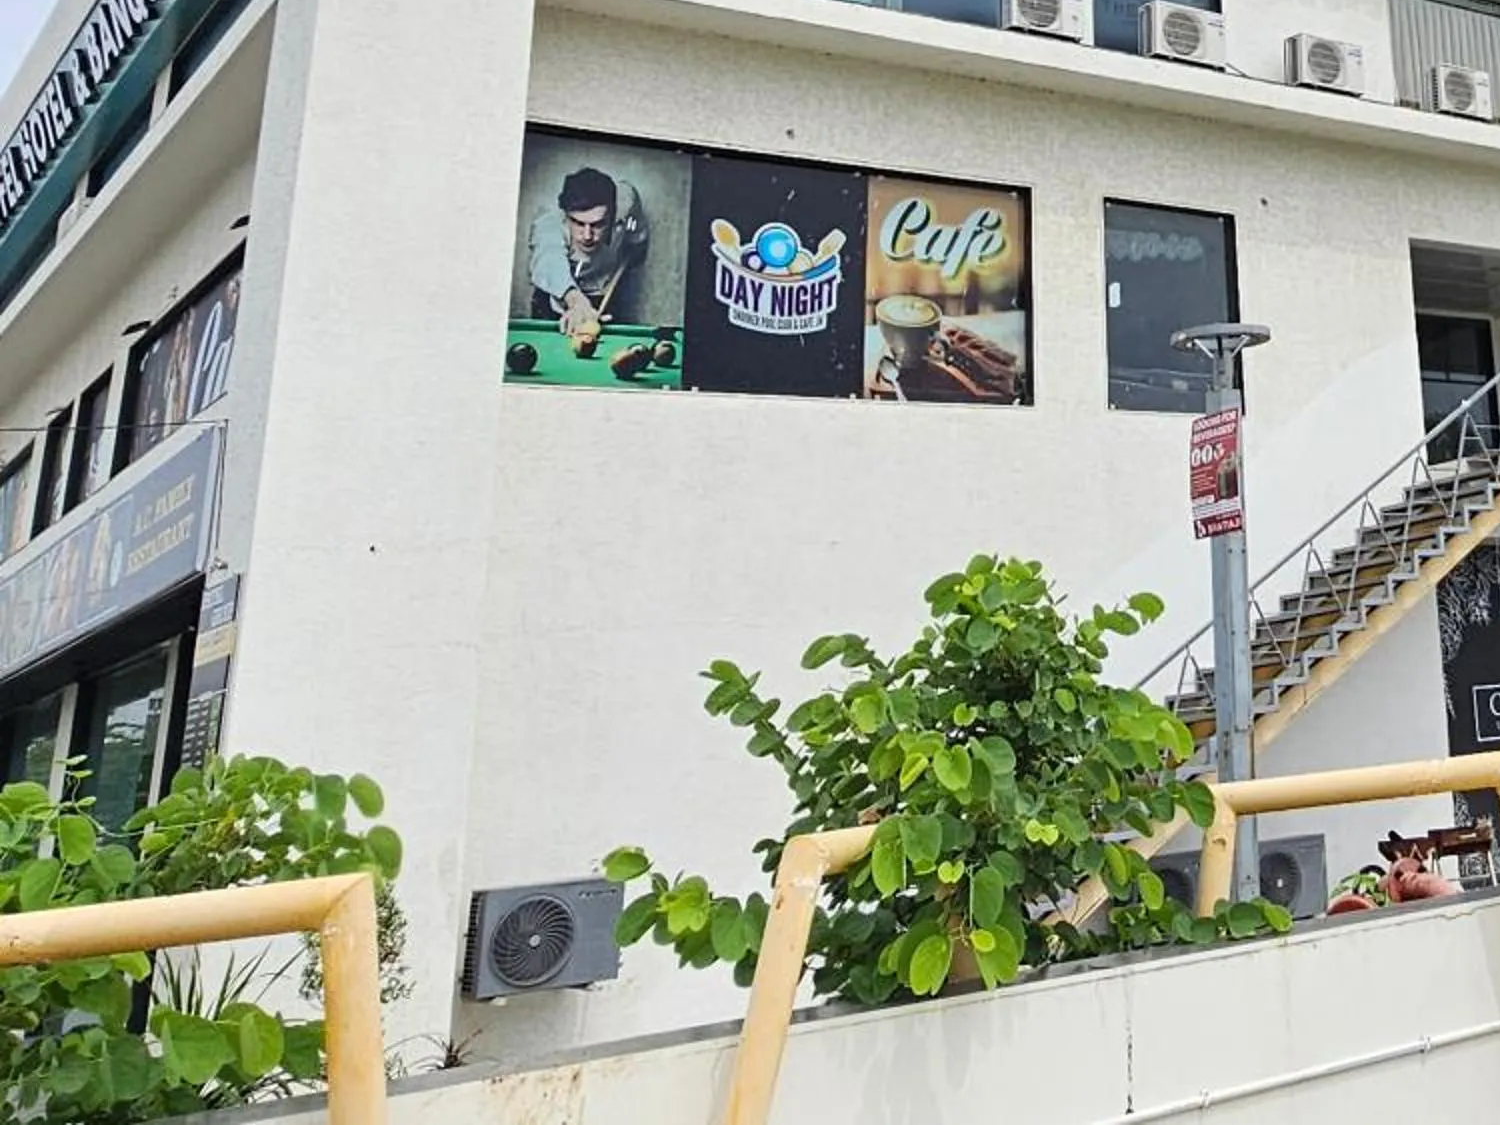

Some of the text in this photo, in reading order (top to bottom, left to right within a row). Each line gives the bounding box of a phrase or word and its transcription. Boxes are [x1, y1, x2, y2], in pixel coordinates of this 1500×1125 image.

[21, 72, 74, 178] HOTEL
[70, 49, 91, 107] &
[720, 264, 837, 317] DAY NIGHT
